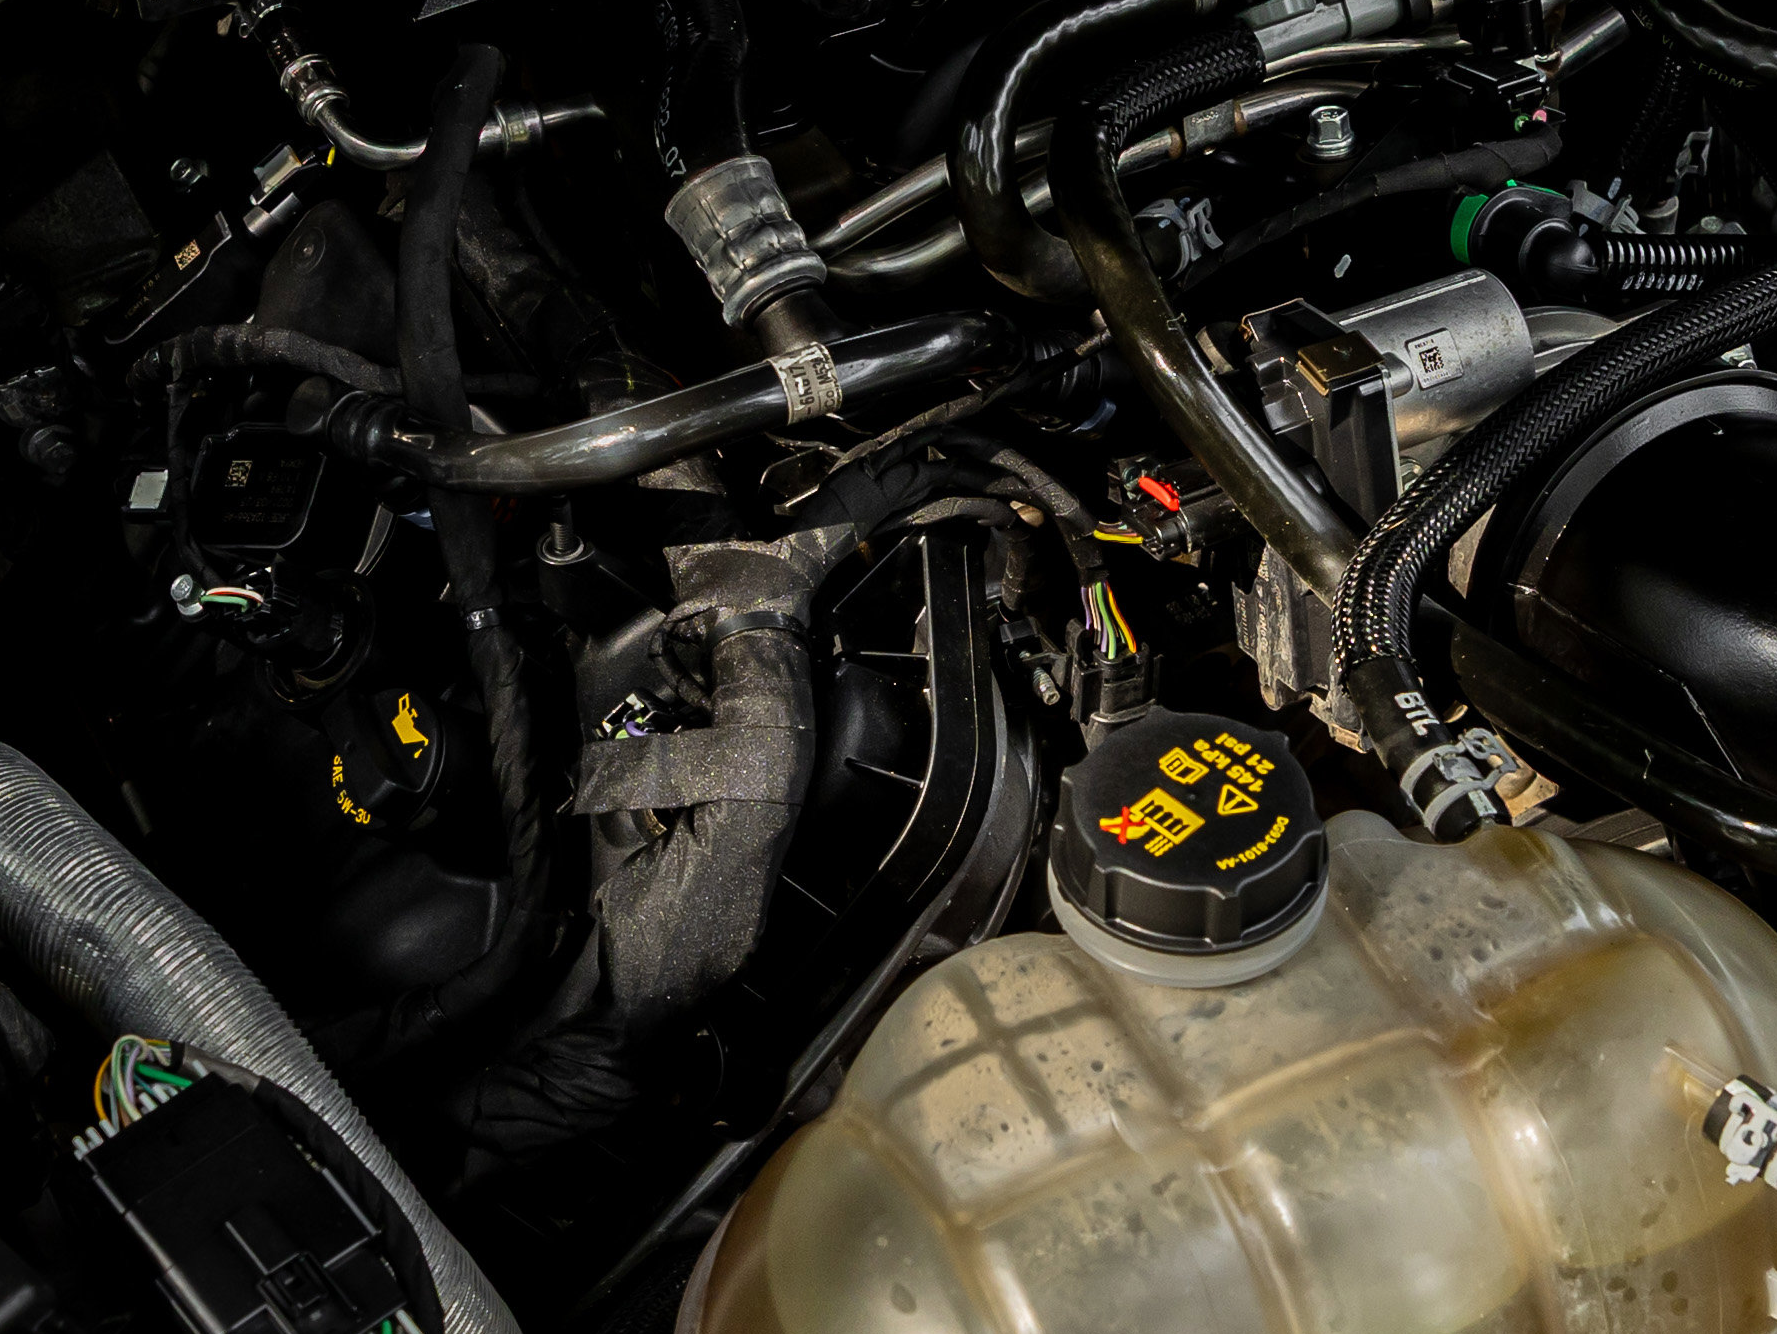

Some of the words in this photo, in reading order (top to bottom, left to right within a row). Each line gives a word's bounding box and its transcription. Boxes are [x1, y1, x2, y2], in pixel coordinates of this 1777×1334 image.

[1193, 738, 1232, 770] kPa
[1214, 732, 1252, 756] psi
[331, 754, 344, 788] SAE
[1225, 764, 1264, 793] 145
[1245, 753, 1276, 775] 21
[336, 788, 372, 825] 5W-30
